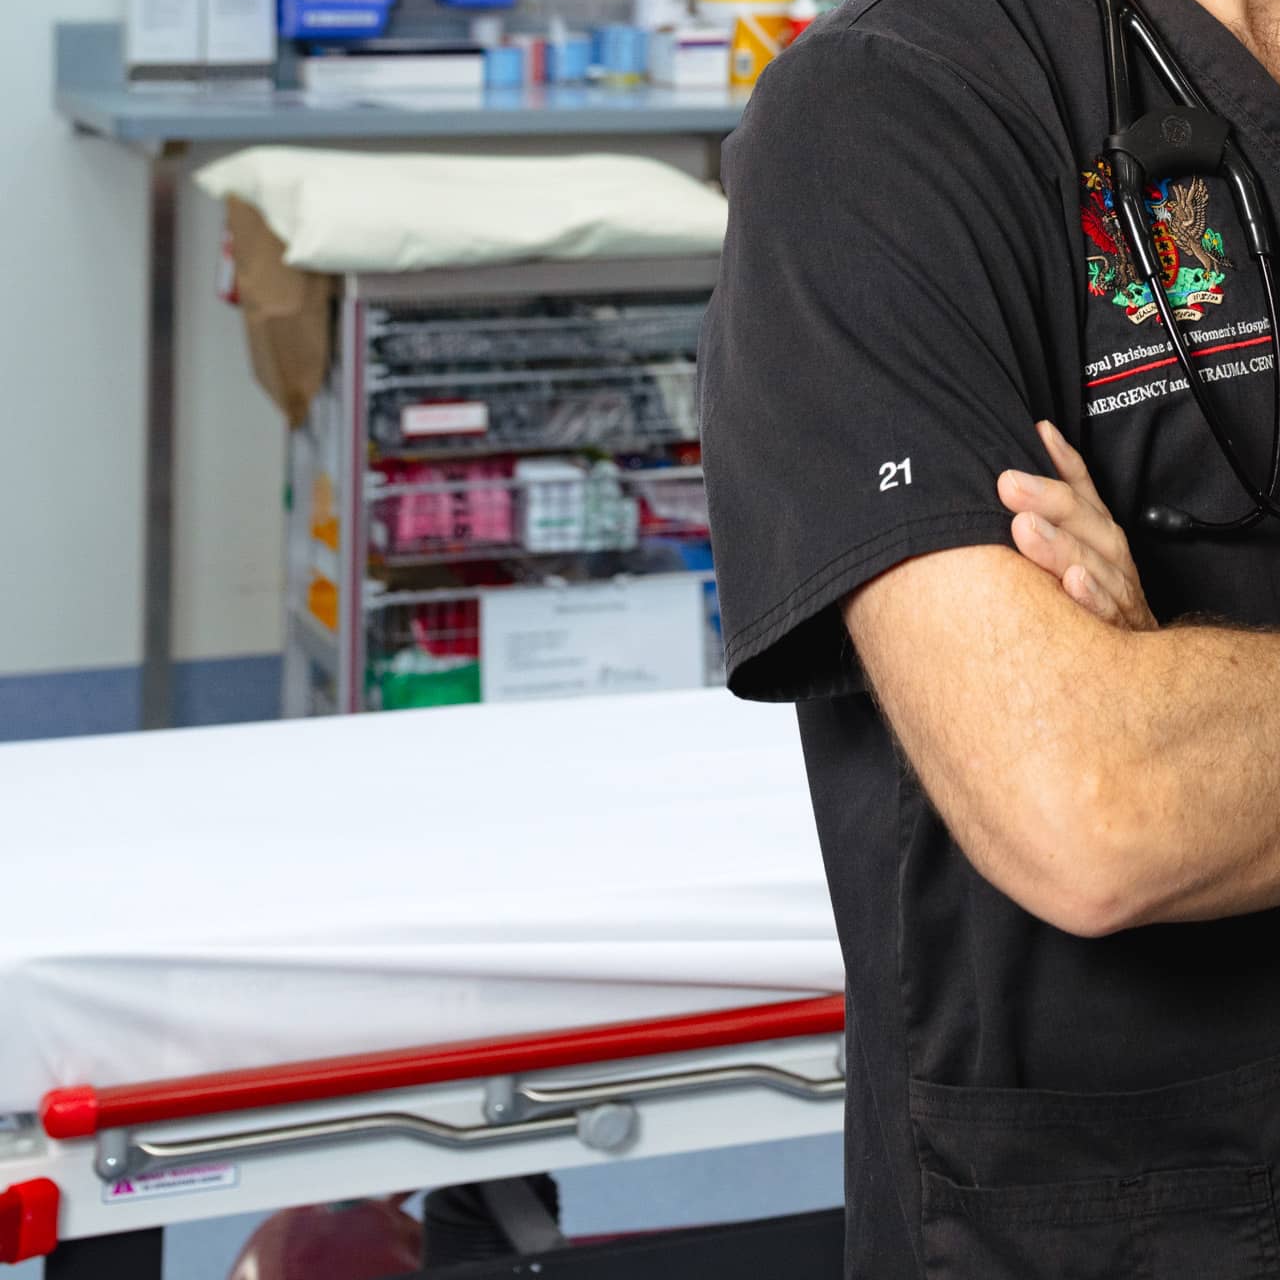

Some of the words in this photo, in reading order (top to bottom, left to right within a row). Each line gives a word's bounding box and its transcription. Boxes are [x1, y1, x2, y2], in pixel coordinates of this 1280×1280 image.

[1085, 355, 1112, 376] oyal
[1112, 345, 1165, 367] Brisbane
[1189, 323, 1236, 344] Women's
[1237, 316, 1271, 334] Hospi
[1087, 379, 1167, 416] MERGENCY
[1198, 361, 1249, 383] TRAUMA
[879, 457, 912, 492] 21
